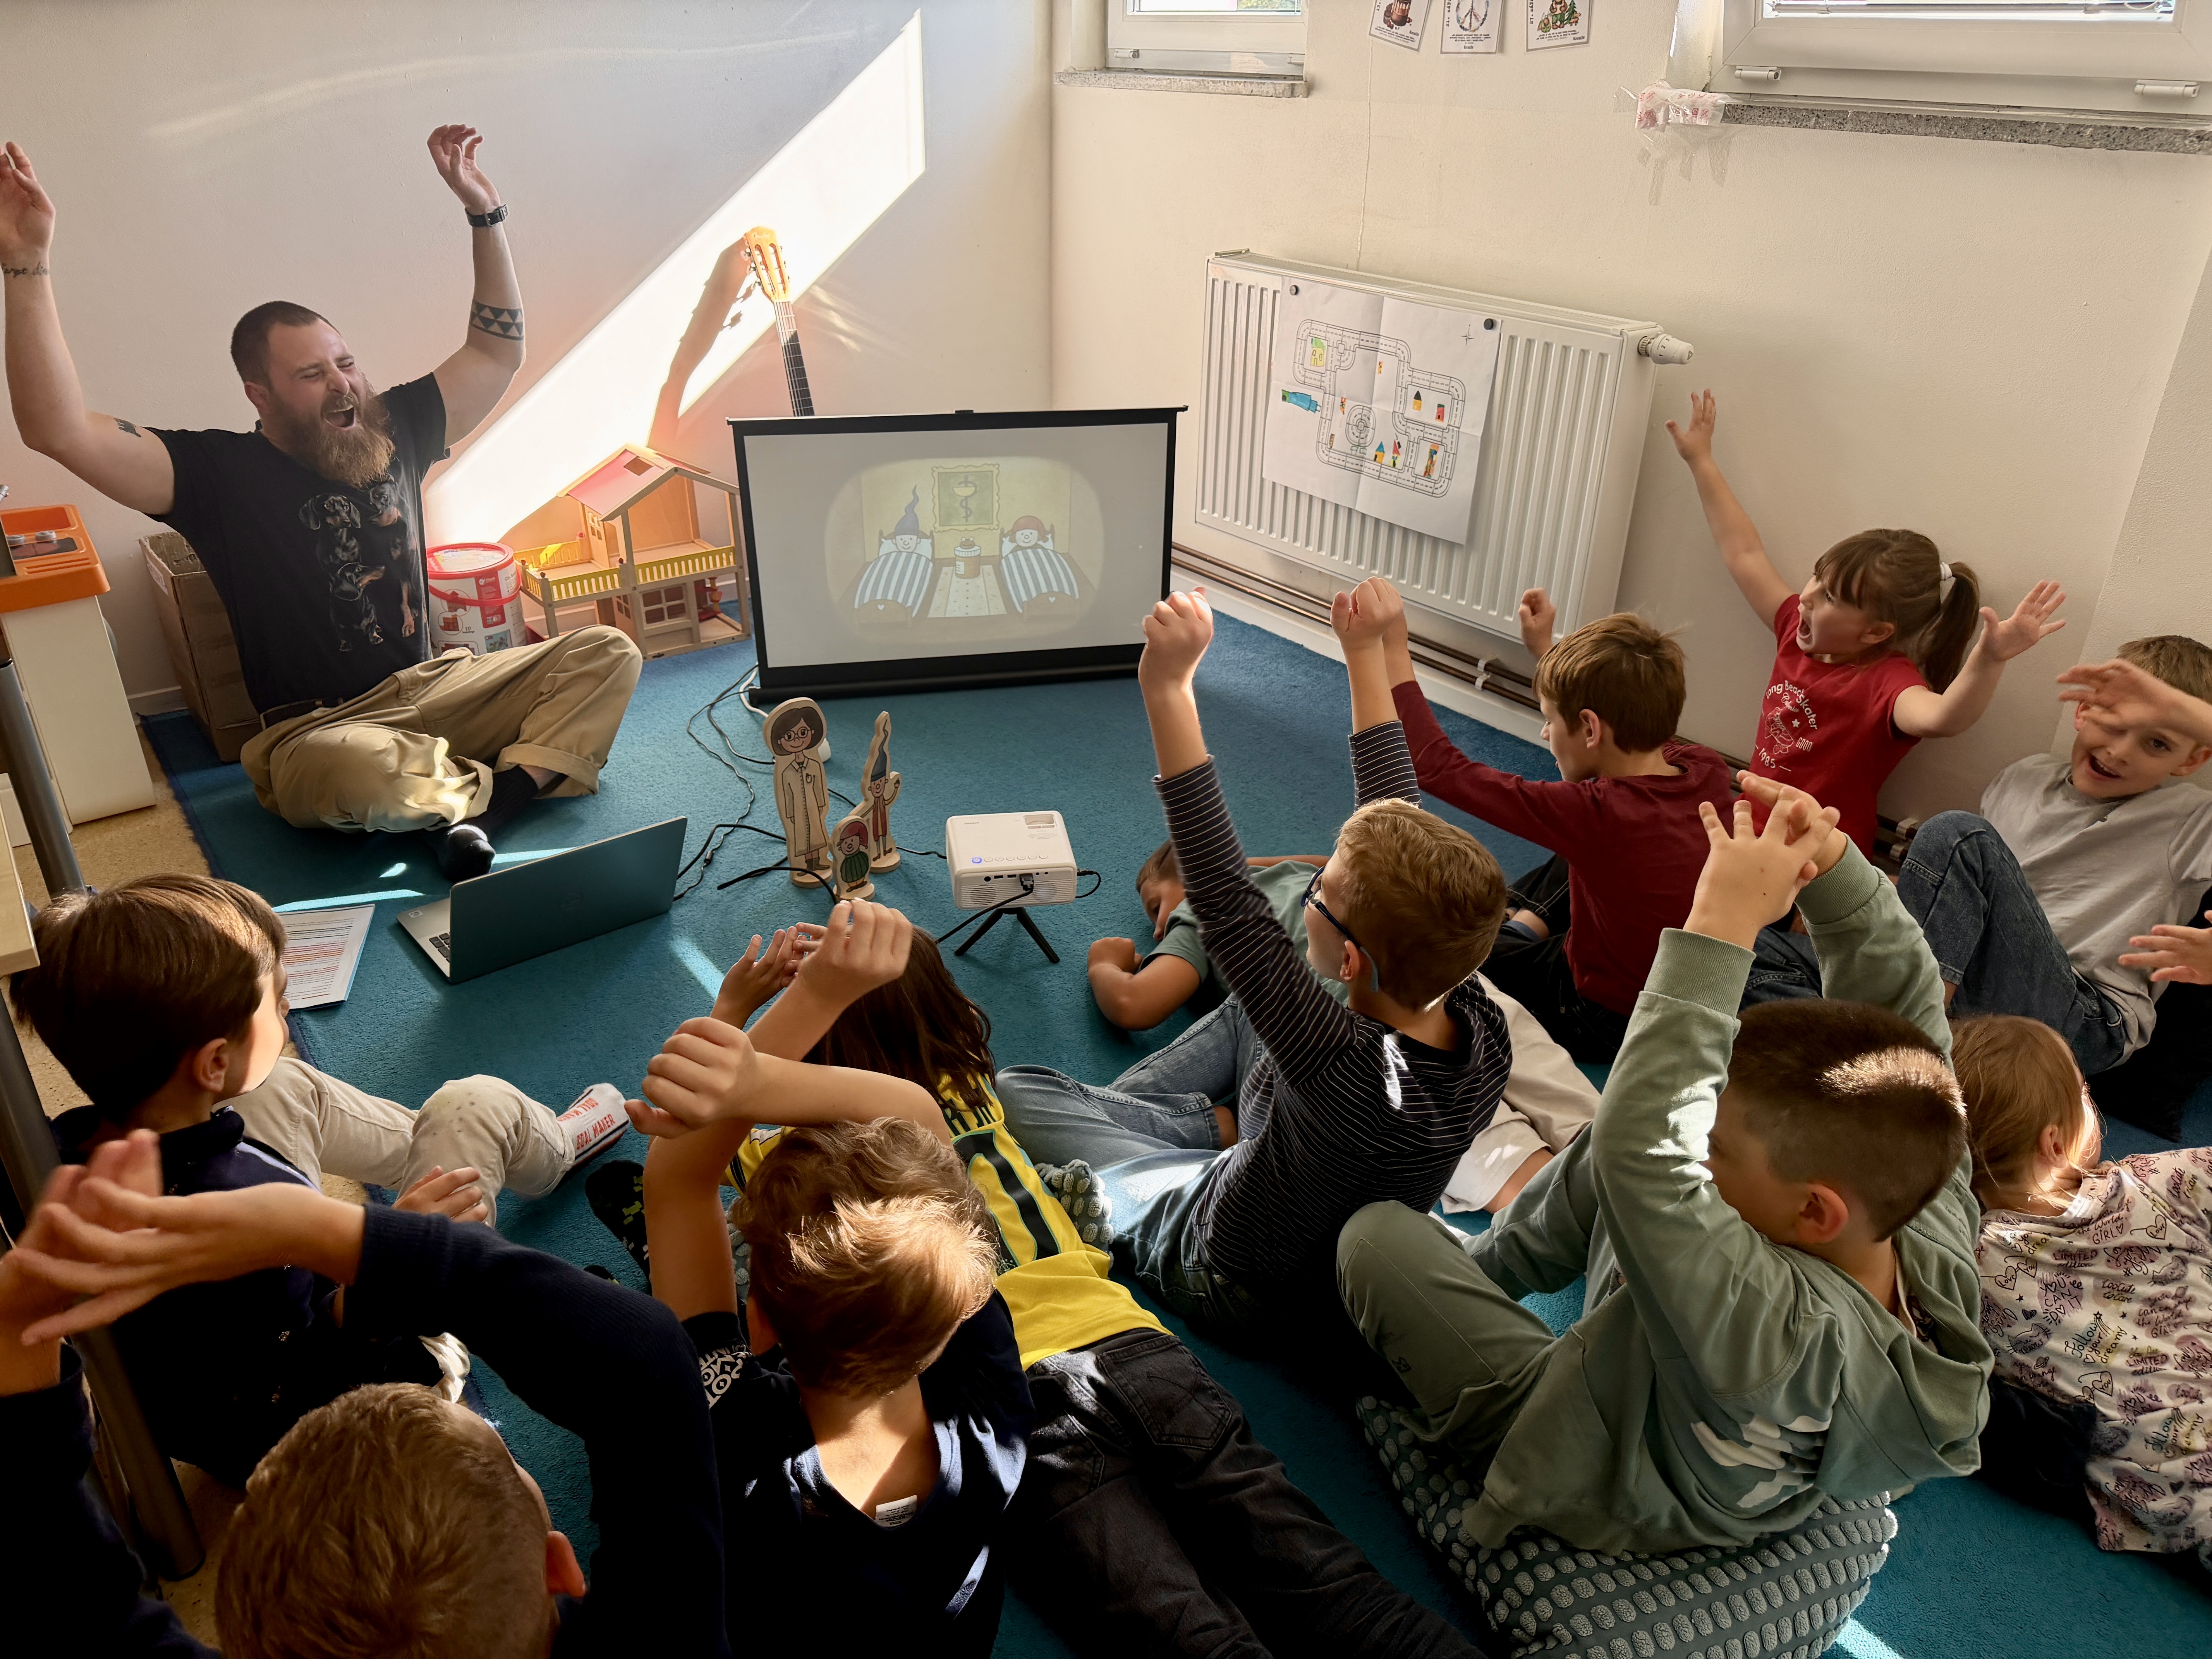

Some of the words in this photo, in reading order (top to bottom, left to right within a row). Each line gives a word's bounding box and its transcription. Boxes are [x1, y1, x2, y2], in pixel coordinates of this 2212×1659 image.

[1766, 684, 1783, 699] Long
[1796, 694, 1818, 730] Skater
[1759, 747, 1776, 769] 1985
[592, 1113, 615, 1138] MAKER
[2092, 1228, 2117, 1245] GIRL
[2053, 1249, 2098, 1261] LIMITED
[2045, 1289, 2072, 1307] CAN
[2068, 1295, 2081, 1309] IT
[2064, 1323, 2099, 1358] Follow
[2088, 1331, 2103, 1355] your
[2126, 1354, 2169, 1367] LIMITED
